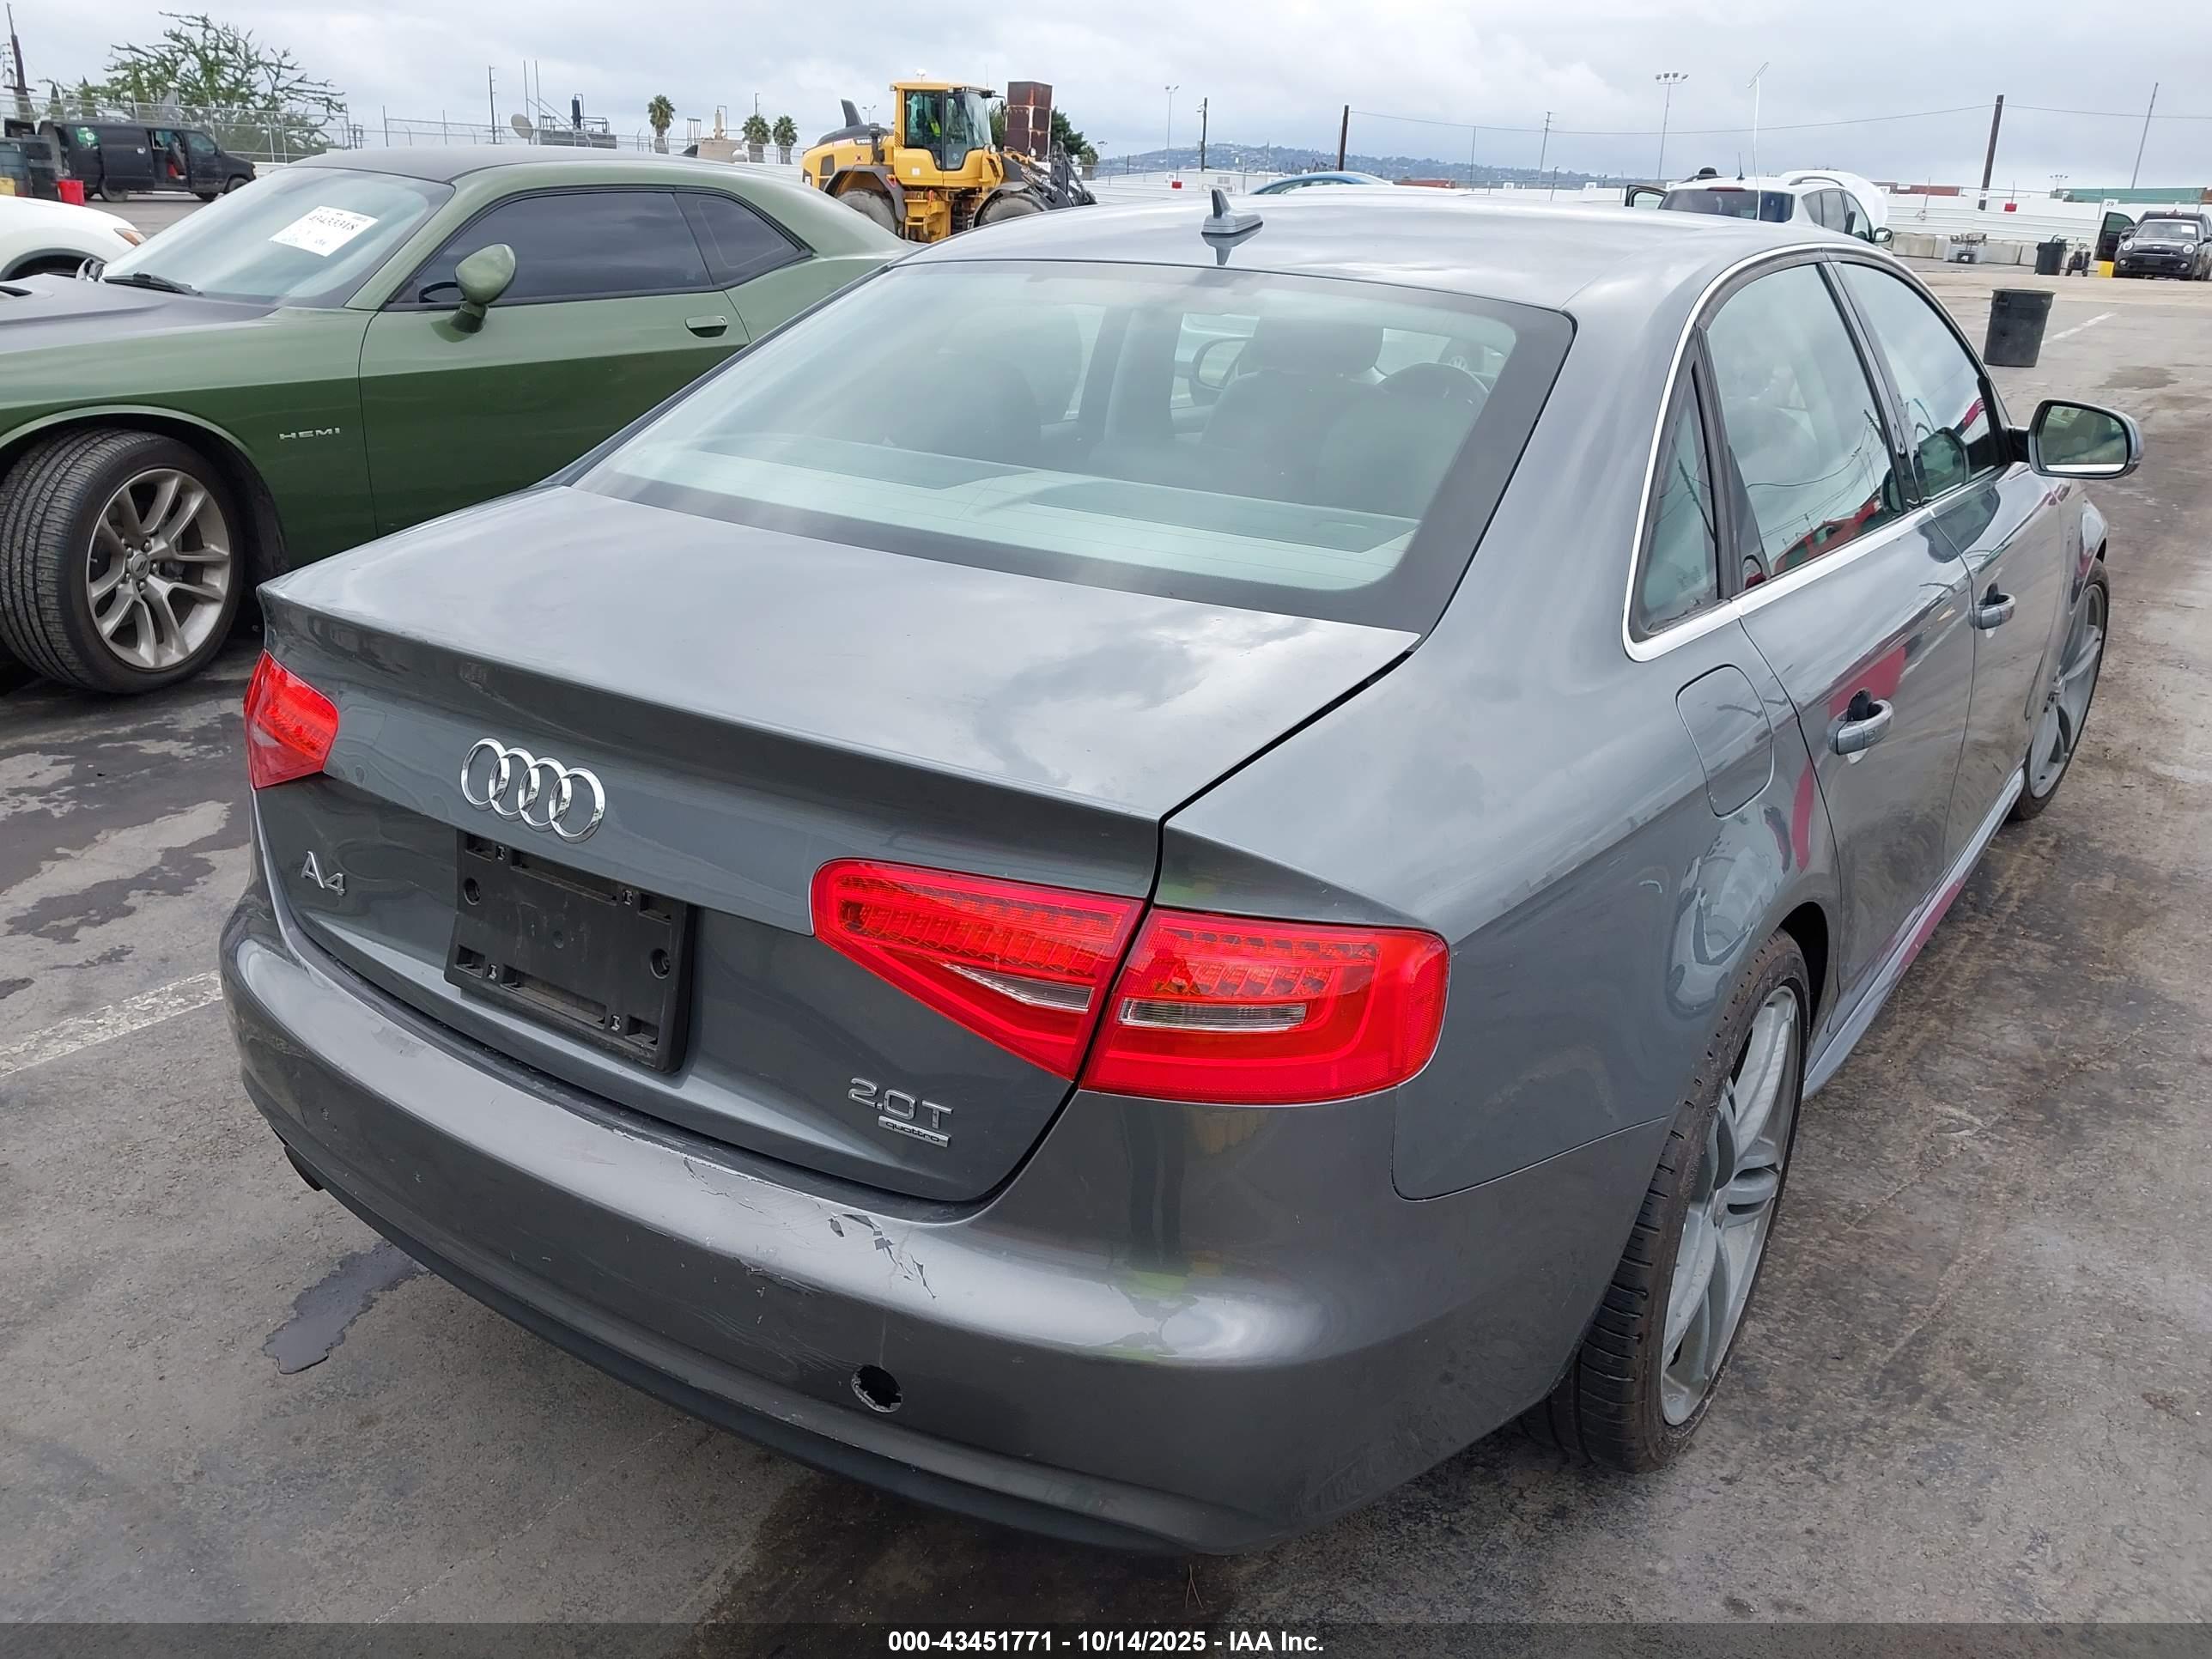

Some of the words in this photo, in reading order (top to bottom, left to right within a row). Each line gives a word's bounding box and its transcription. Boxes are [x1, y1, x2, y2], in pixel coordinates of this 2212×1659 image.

[278, 427, 341, 440] HEMI
[301, 850, 345, 896] A4
[848, 1077, 955, 1130] 2.0T
[885, 1121, 940, 1143] quattro
